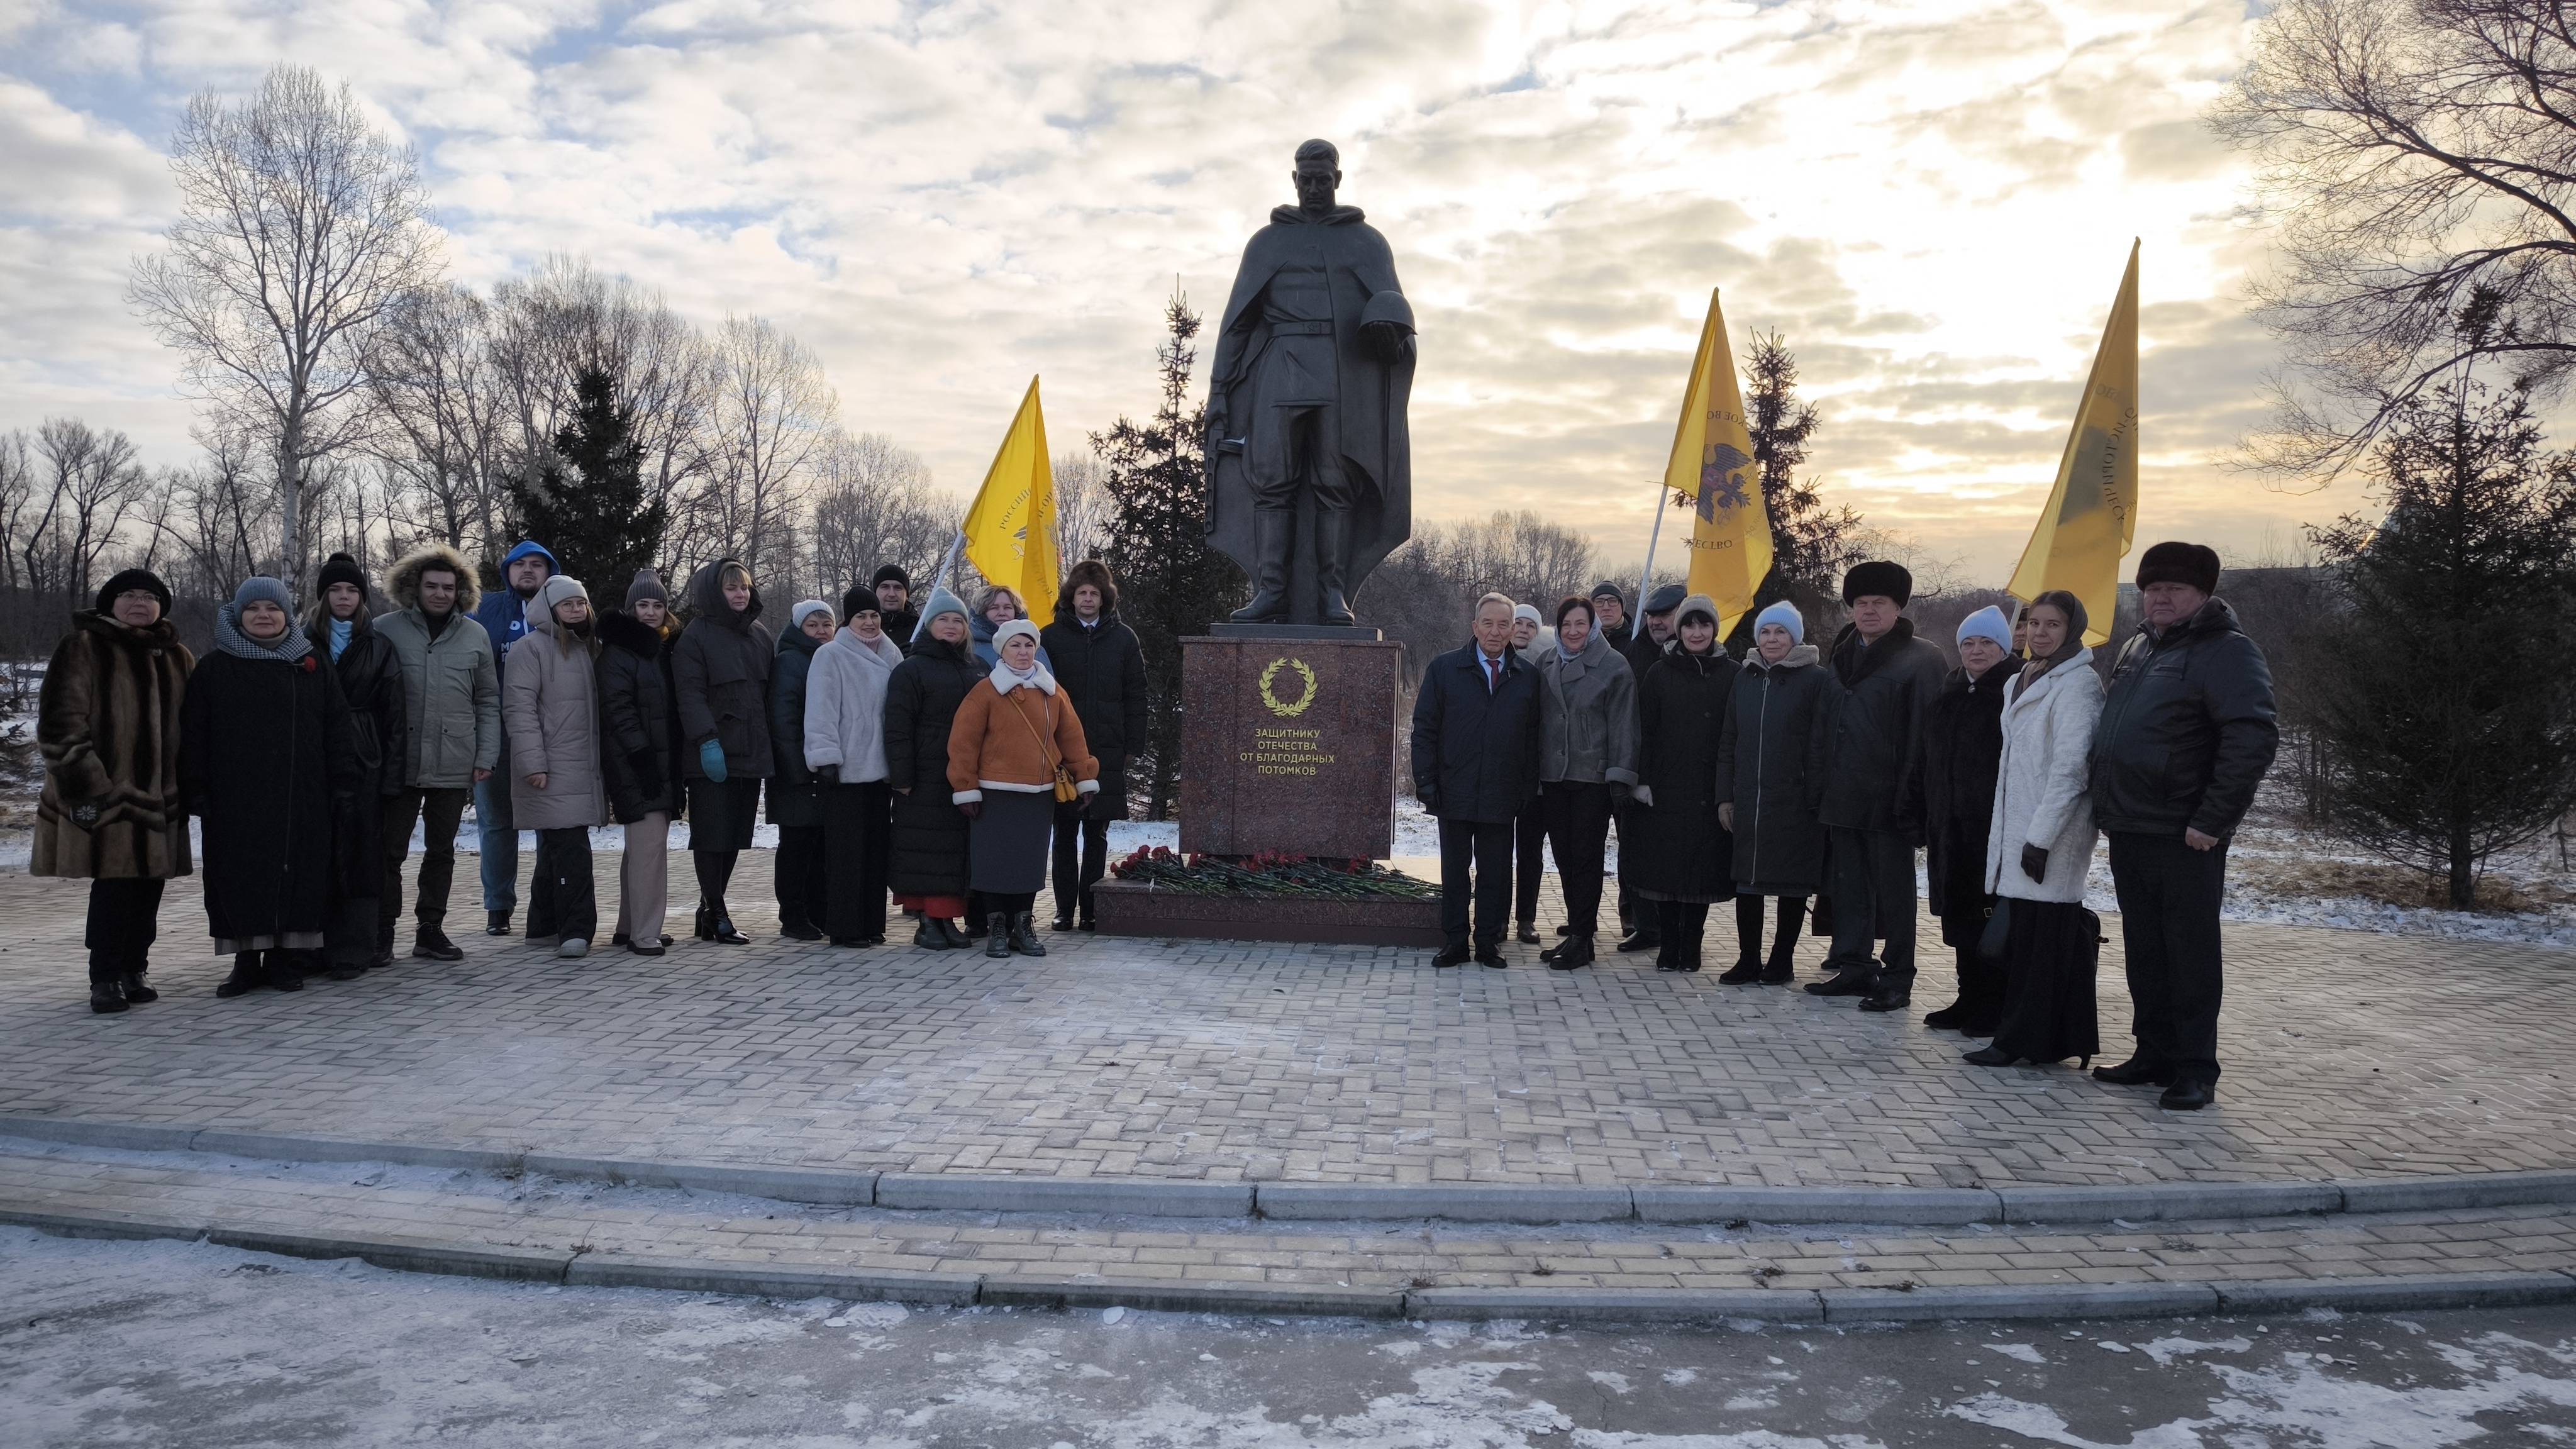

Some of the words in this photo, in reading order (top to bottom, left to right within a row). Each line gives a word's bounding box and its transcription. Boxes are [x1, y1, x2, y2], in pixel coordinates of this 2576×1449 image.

[1255, 728, 1321, 738] ЗАЩИТНИКУ
[1258, 741, 1318, 750] ОТЕЧЕСТВА
[1240, 753, 1253, 761] ОТ
[1257, 753, 1335, 763] БЛАГОДАРНЫХ
[1258, 765, 1316, 775] ПОТОМКОВ
